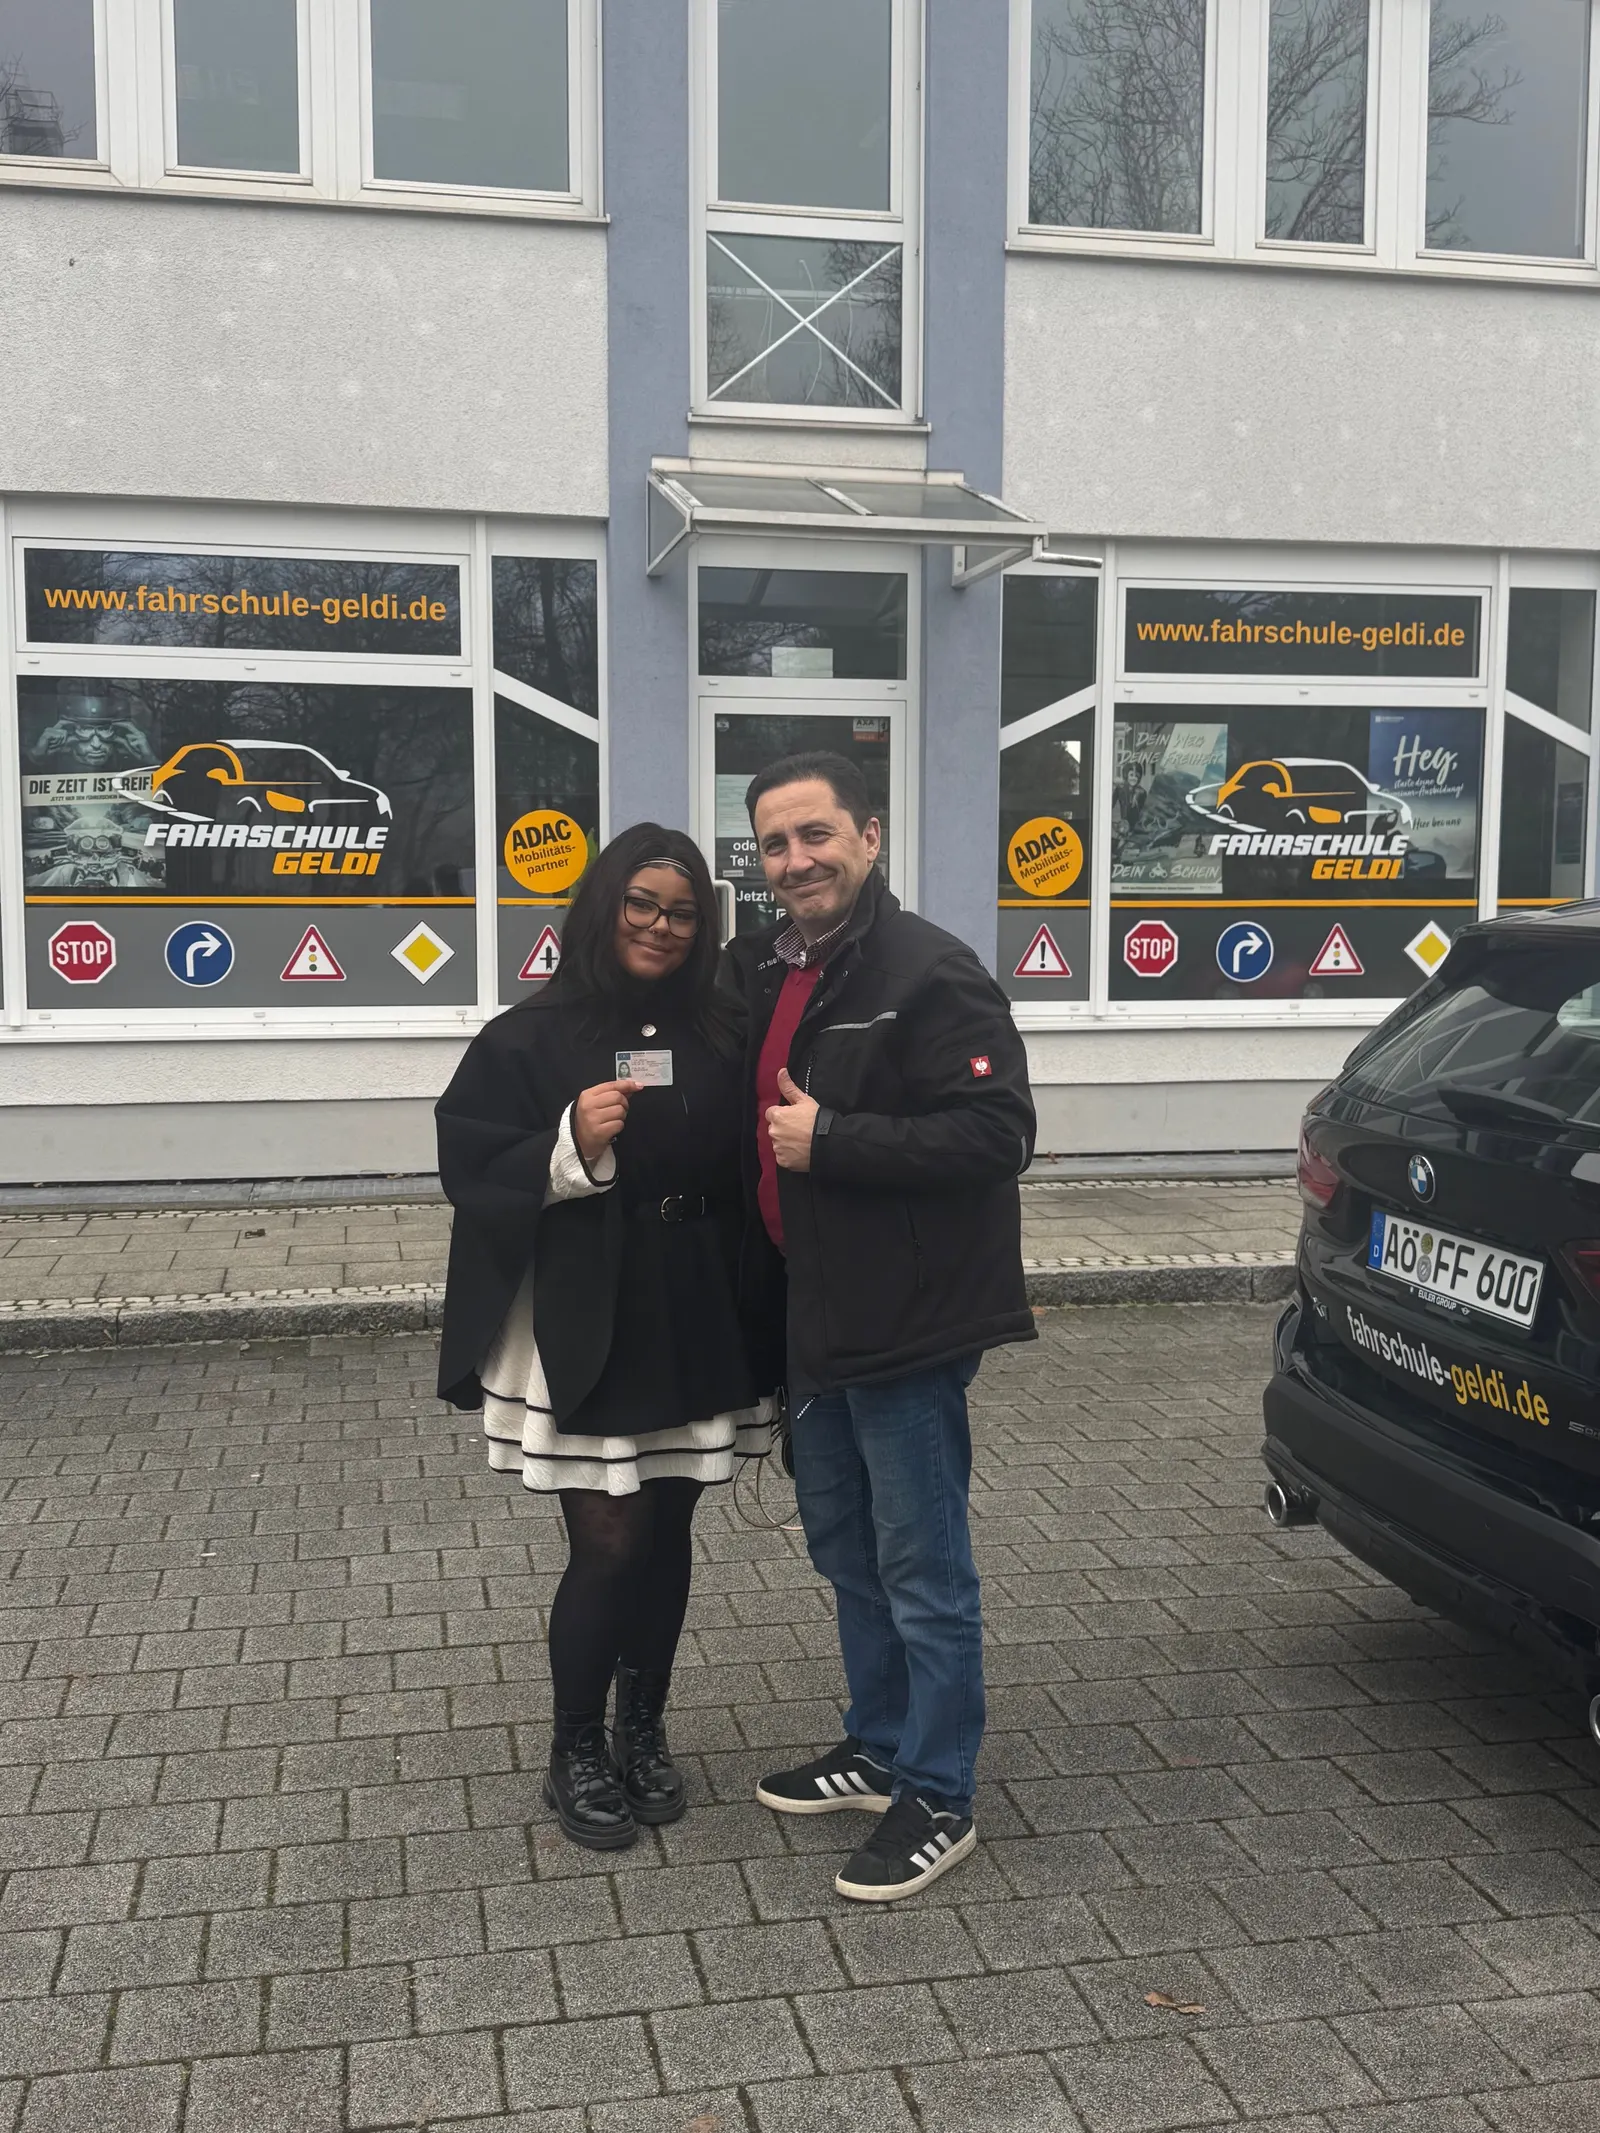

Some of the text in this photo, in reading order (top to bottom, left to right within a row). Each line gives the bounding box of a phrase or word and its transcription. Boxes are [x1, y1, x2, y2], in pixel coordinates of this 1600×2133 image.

[43, 585, 447, 625] www.fahrschule-geldi.de
[1137, 619, 1465, 651] www.fahrschule-geldi.de
[1136, 731, 1170, 747] DEIN
[1119, 750, 1162, 765] DEINE
[1393, 734, 1458, 785] Hey,
[29, 779, 51, 794] DIE
[56, 778, 88, 793] ZEIT
[93, 777, 114, 793] IST
[144, 823, 389, 849] FAHRSCHULE
[512, 819, 572, 852] ADAC
[733, 840, 757, 851] ode
[1014, 826, 1067, 868] ADAC
[1208, 834, 1409, 856] FAHRSCHULE
[272, 852, 381, 875] GELDI
[514, 844, 576, 864] Mobilitäts-
[730, 855, 757, 867] Tel.:
[1020, 848, 1073, 879] Mobilitäts-
[527, 858, 569, 877] partner
[1033, 862, 1070, 888] partner
[1112, 863, 1146, 878] DEIN
[1311, 858, 1402, 880] GELDI
[736, 891, 768, 902] Jetzt
[55, 940, 108, 965] STOP
[1129, 937, 1172, 960] STOP
[1373, 1222, 1538, 1315] D AÖ FF 600
[1418, 1289, 1457, 1311] EULER GROUP
[1346, 1305, 1550, 1426] fahrschule-geldi.de
